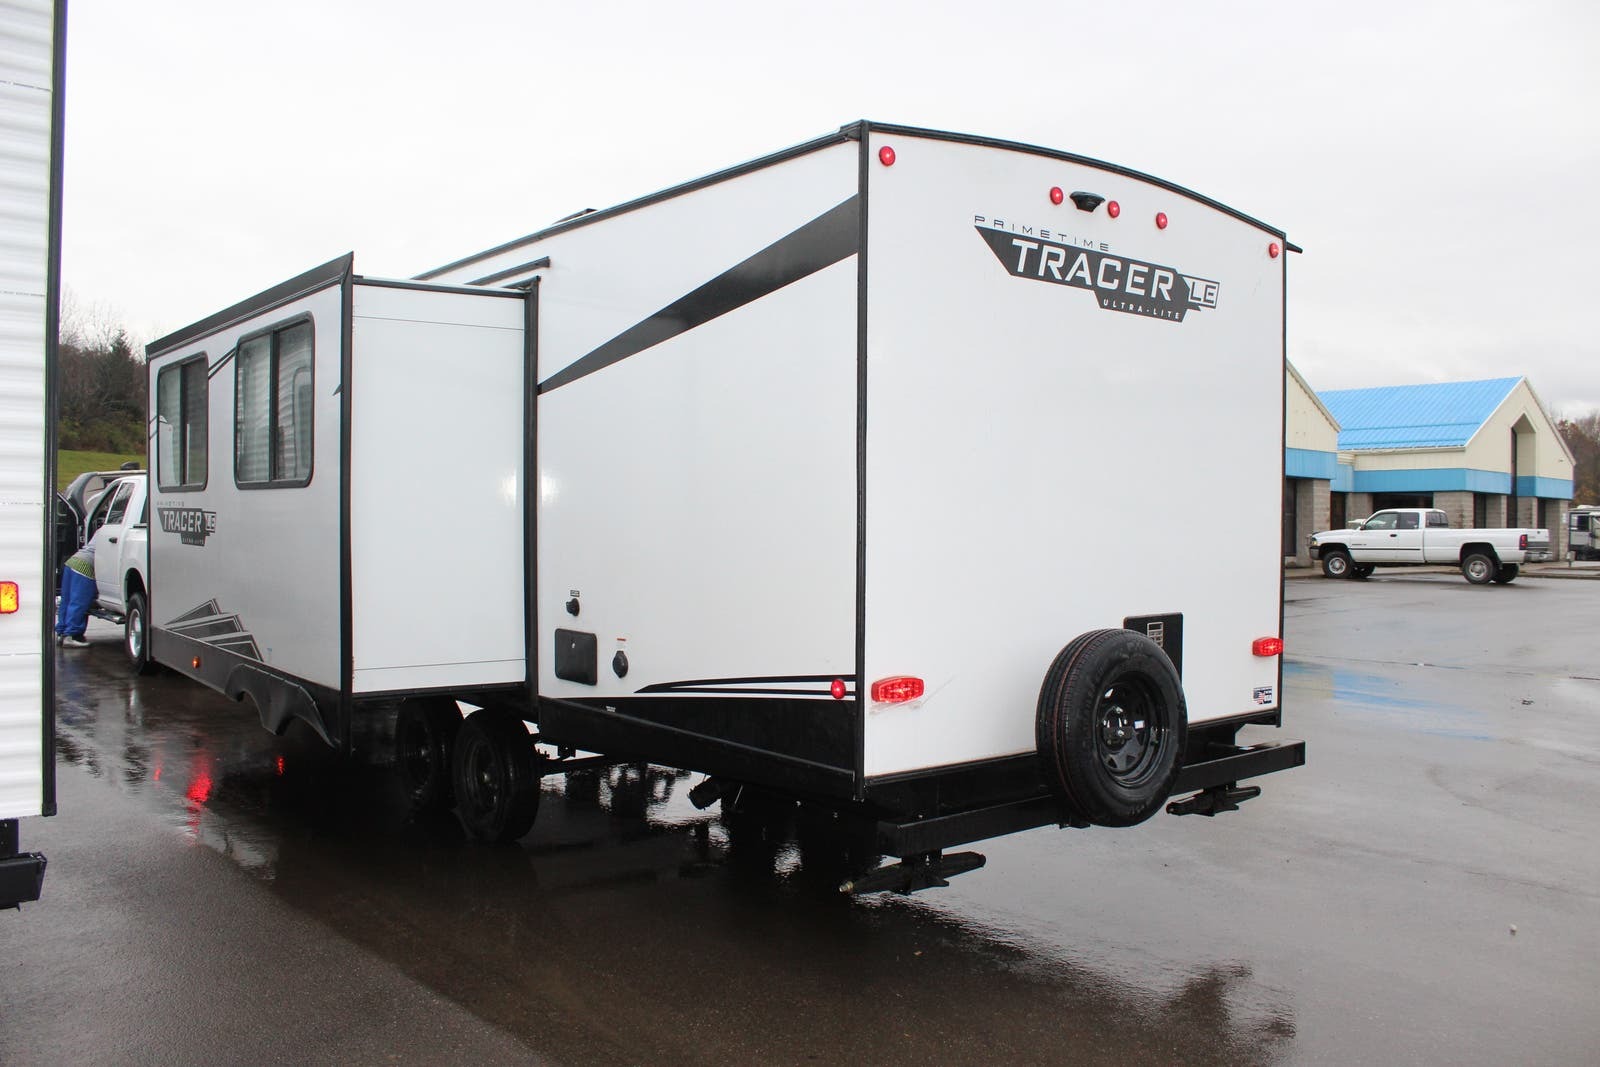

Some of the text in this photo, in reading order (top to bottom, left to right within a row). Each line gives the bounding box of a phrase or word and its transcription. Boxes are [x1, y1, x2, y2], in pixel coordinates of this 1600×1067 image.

[974, 214, 1110, 252] PRIMETIME
[1011, 237, 1218, 306] TRACER LE
[163, 510, 202, 532] TRACER
